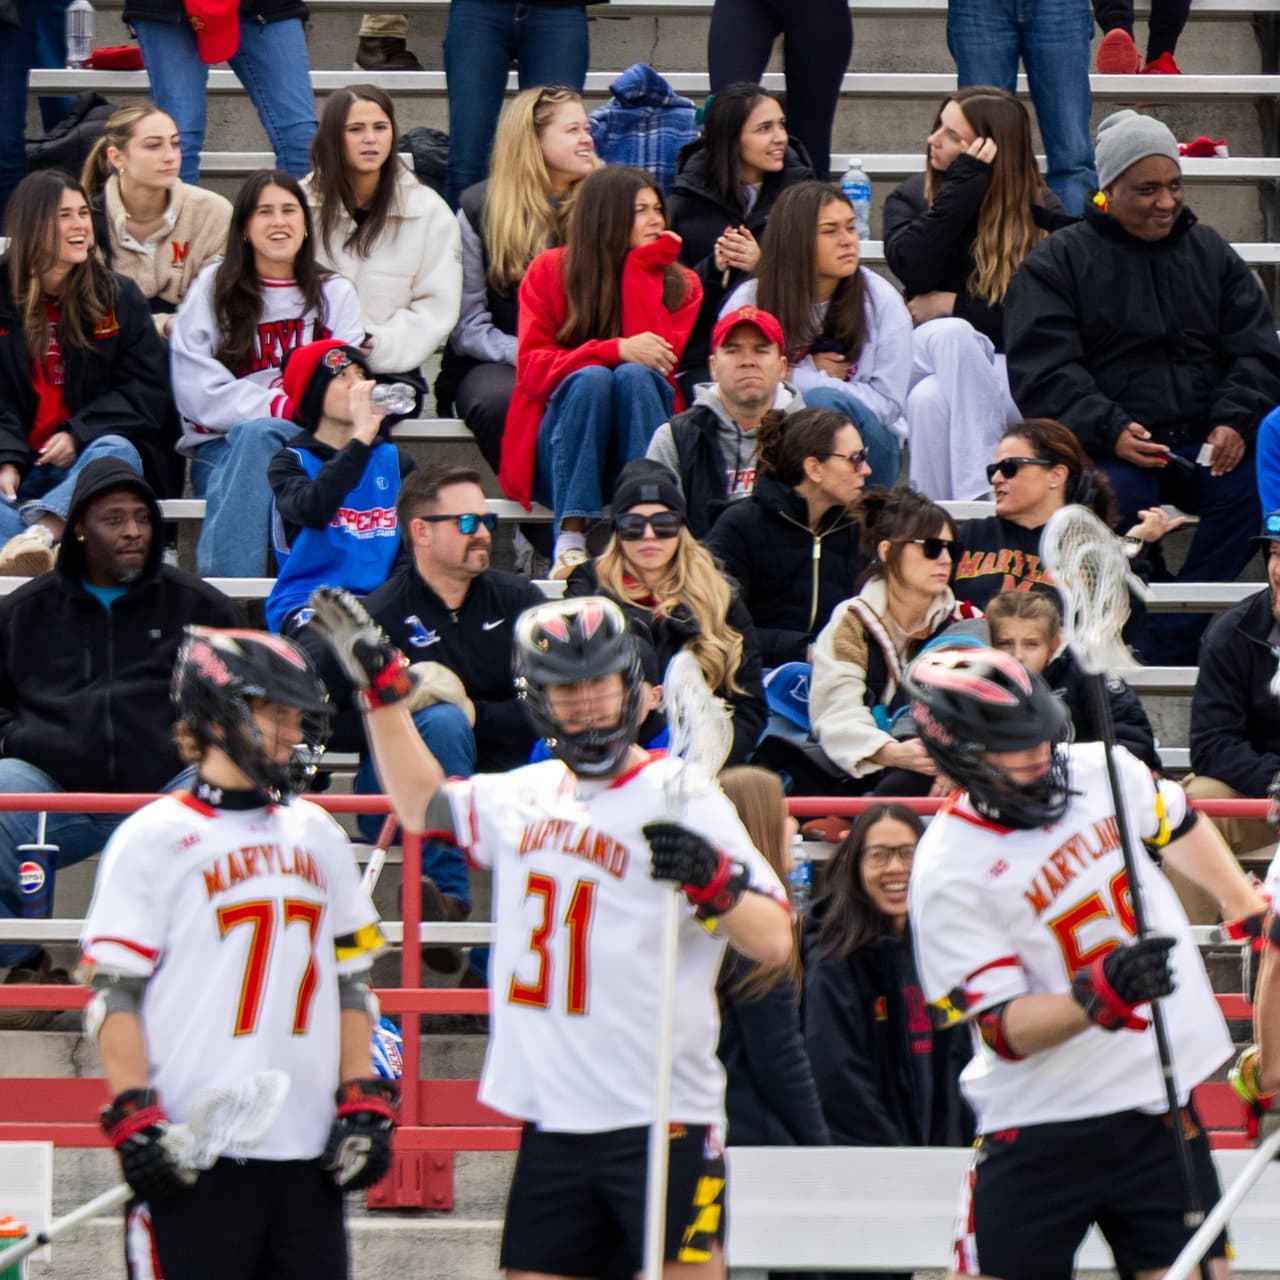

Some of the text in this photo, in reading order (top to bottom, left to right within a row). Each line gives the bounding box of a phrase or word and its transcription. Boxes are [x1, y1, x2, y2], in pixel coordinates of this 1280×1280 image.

[956, 548, 1058, 587] MARYL
[518, 818, 630, 880] MARYLAND
[1022, 812, 1122, 920] MARYLAN
[216, 899, 327, 1039] 77
[506, 872, 600, 1020] 31
